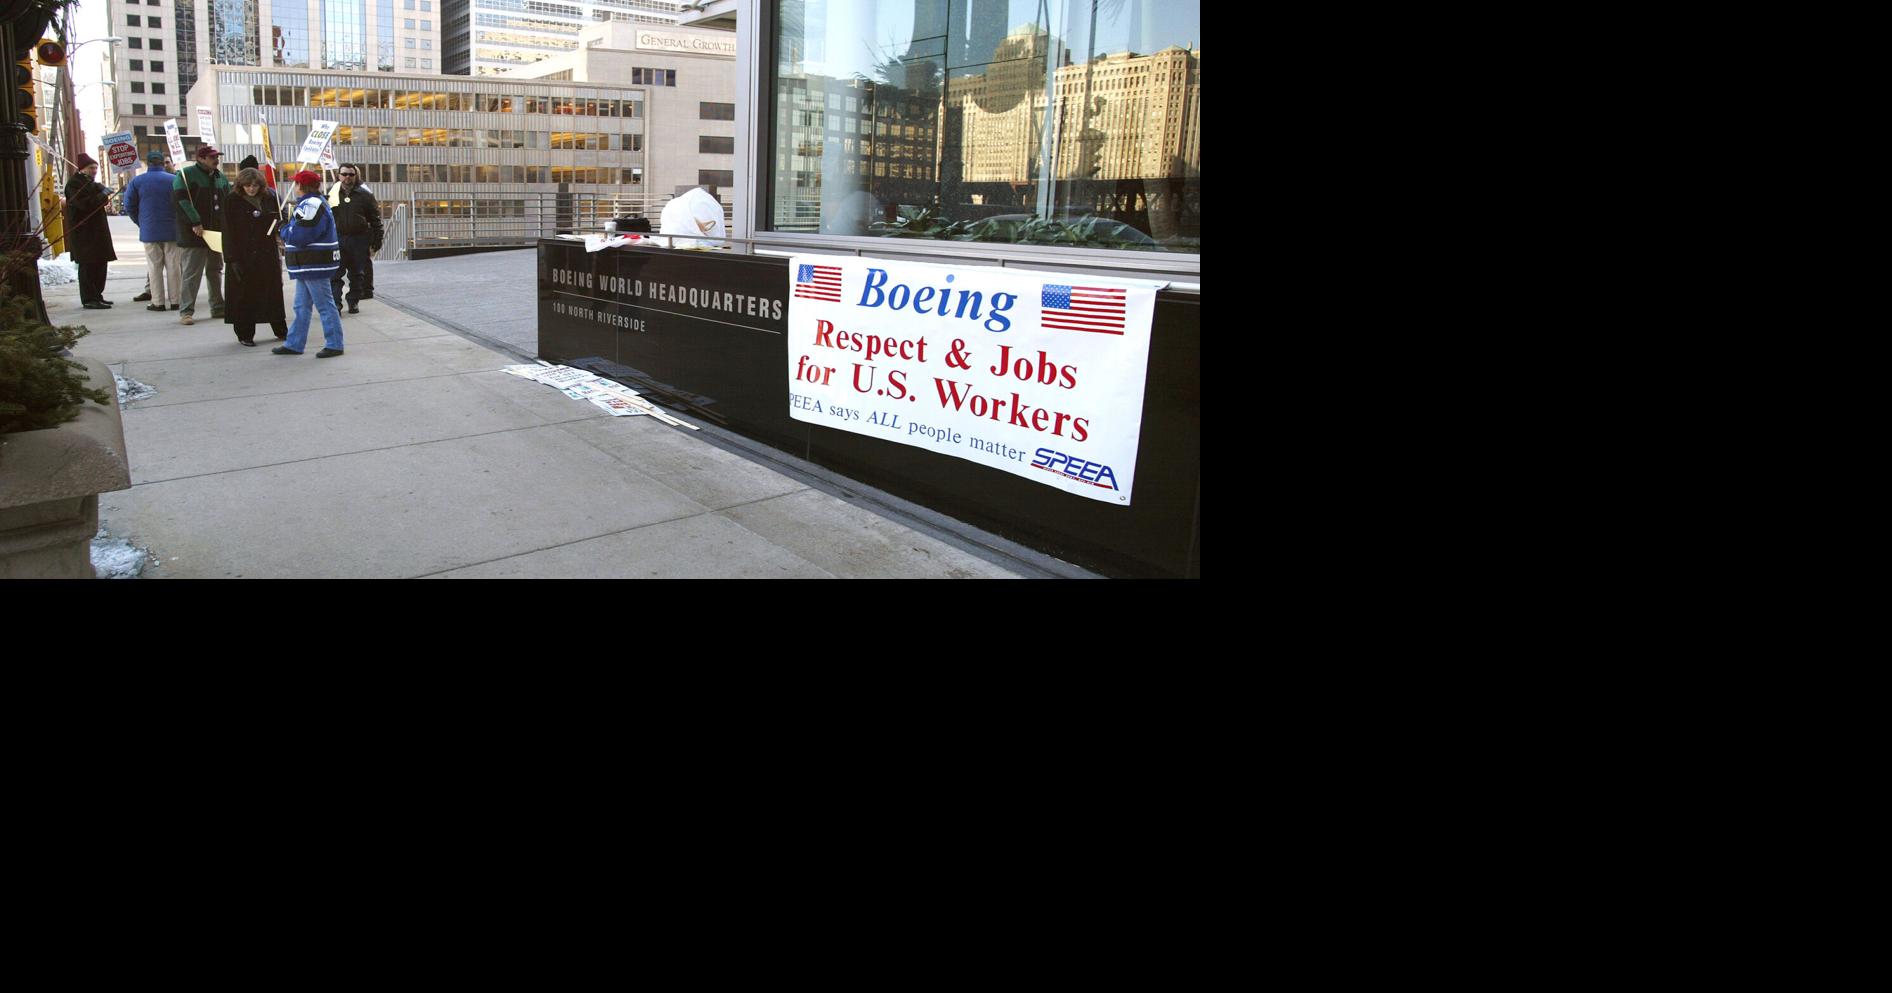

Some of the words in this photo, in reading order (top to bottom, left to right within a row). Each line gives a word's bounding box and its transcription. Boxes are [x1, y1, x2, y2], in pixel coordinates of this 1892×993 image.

[641, 33, 689, 49] GENERAL
[692, 38, 735, 52] GROWTH
[111, 144, 129, 153] STOP
[552, 268, 593, 289] BOEING
[600, 274, 643, 297] WORLD
[649, 282, 783, 321] HEADQUARTERS
[552, 302, 565, 314] 100
[568, 305, 594, 321] NORTH
[597, 311, 646, 333] RIVERSIDE
[856, 267, 1018, 332] Boeing
[813, 319, 928, 363] Respect
[944, 338, 972, 371] &
[989, 344, 1078, 390] Jobs
[795, 354, 837, 386] for
[852, 363, 916, 403] U.S.
[933, 377, 1090, 443] Workers
[829, 404, 860, 421] says
[866, 410, 902, 430] ALL
[908, 421, 962, 444] people
[969, 436, 1027, 463] matter
[1032, 447, 1120, 491] SPEEA
